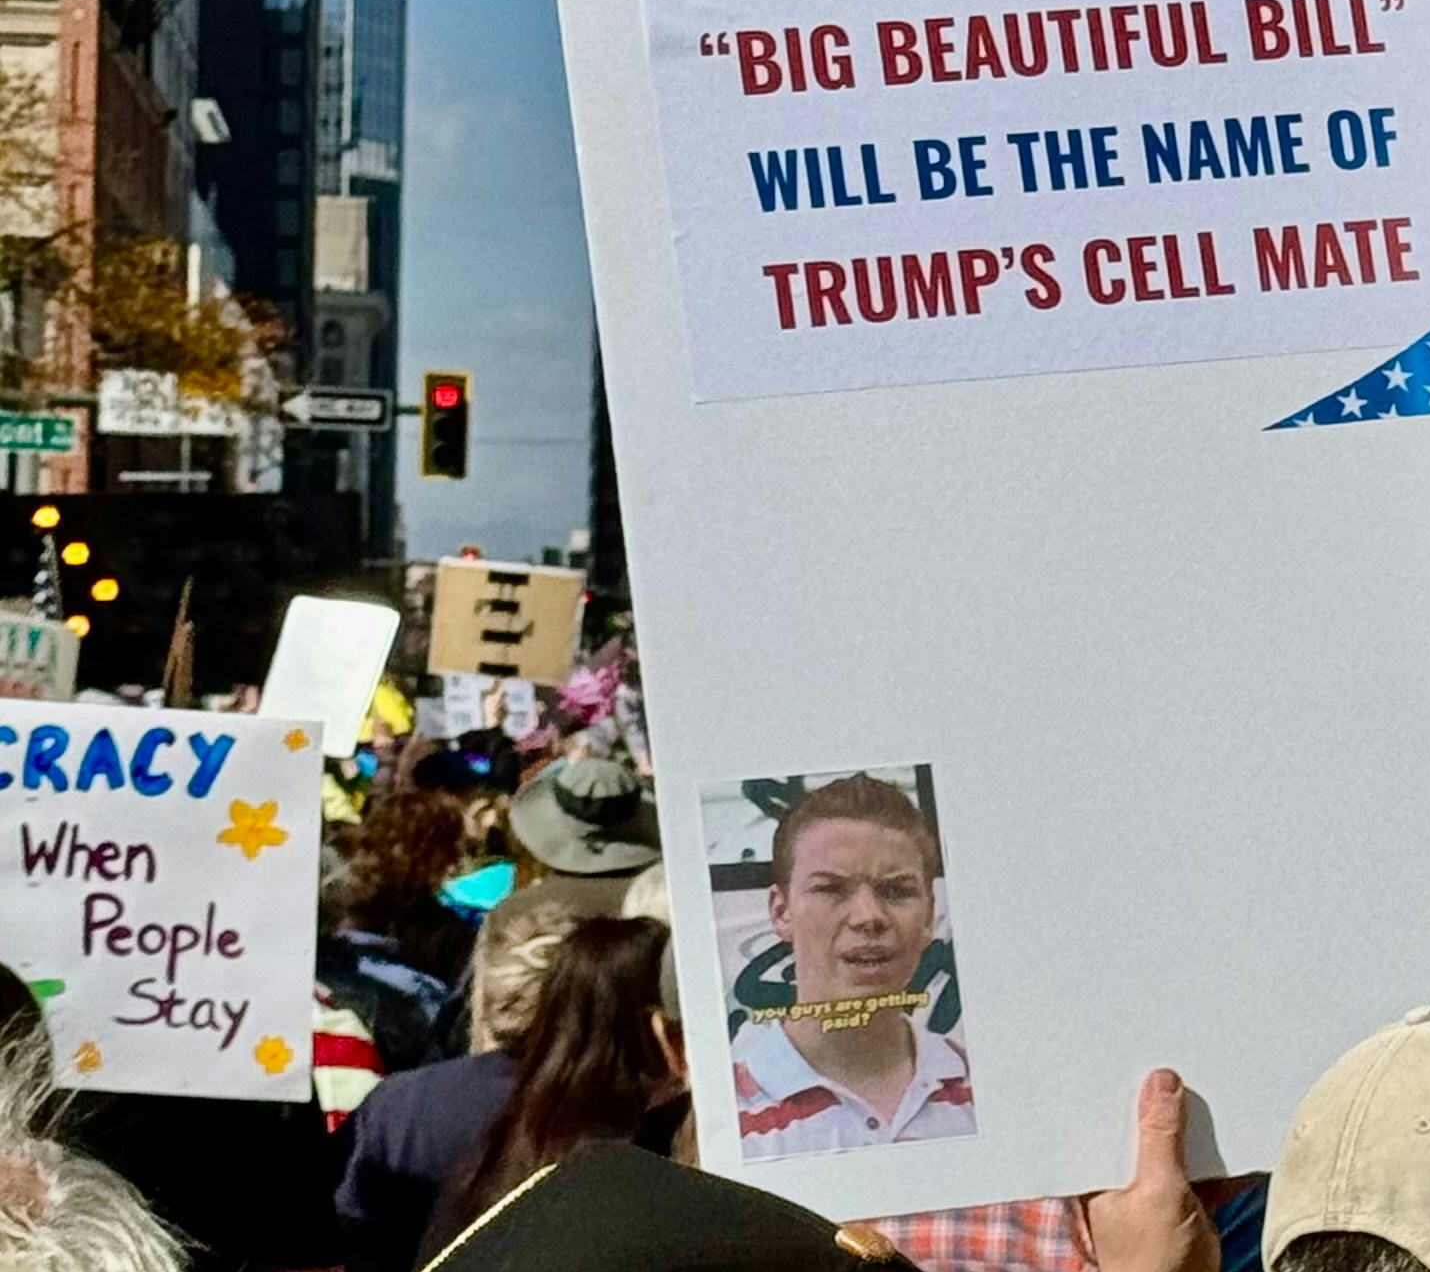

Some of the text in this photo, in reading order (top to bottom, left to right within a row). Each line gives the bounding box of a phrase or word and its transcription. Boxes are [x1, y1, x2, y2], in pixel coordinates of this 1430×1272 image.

[699, 24, 857, 96] “BIG
[875, 0, 1229, 86] BEAUTIFUL
[747, 106, 1397, 214] WILL BE THE NAME OF
[761, 216, 1421, 331] TRUMP’S CELL MATE
[20, 821, 156, 883] When
[82, 891, 246, 985] People
[113, 977, 250, 1051] Stay
[754, 991, 929, 1023] you guys are getting
[821, 1011, 871, 1033] paid?
